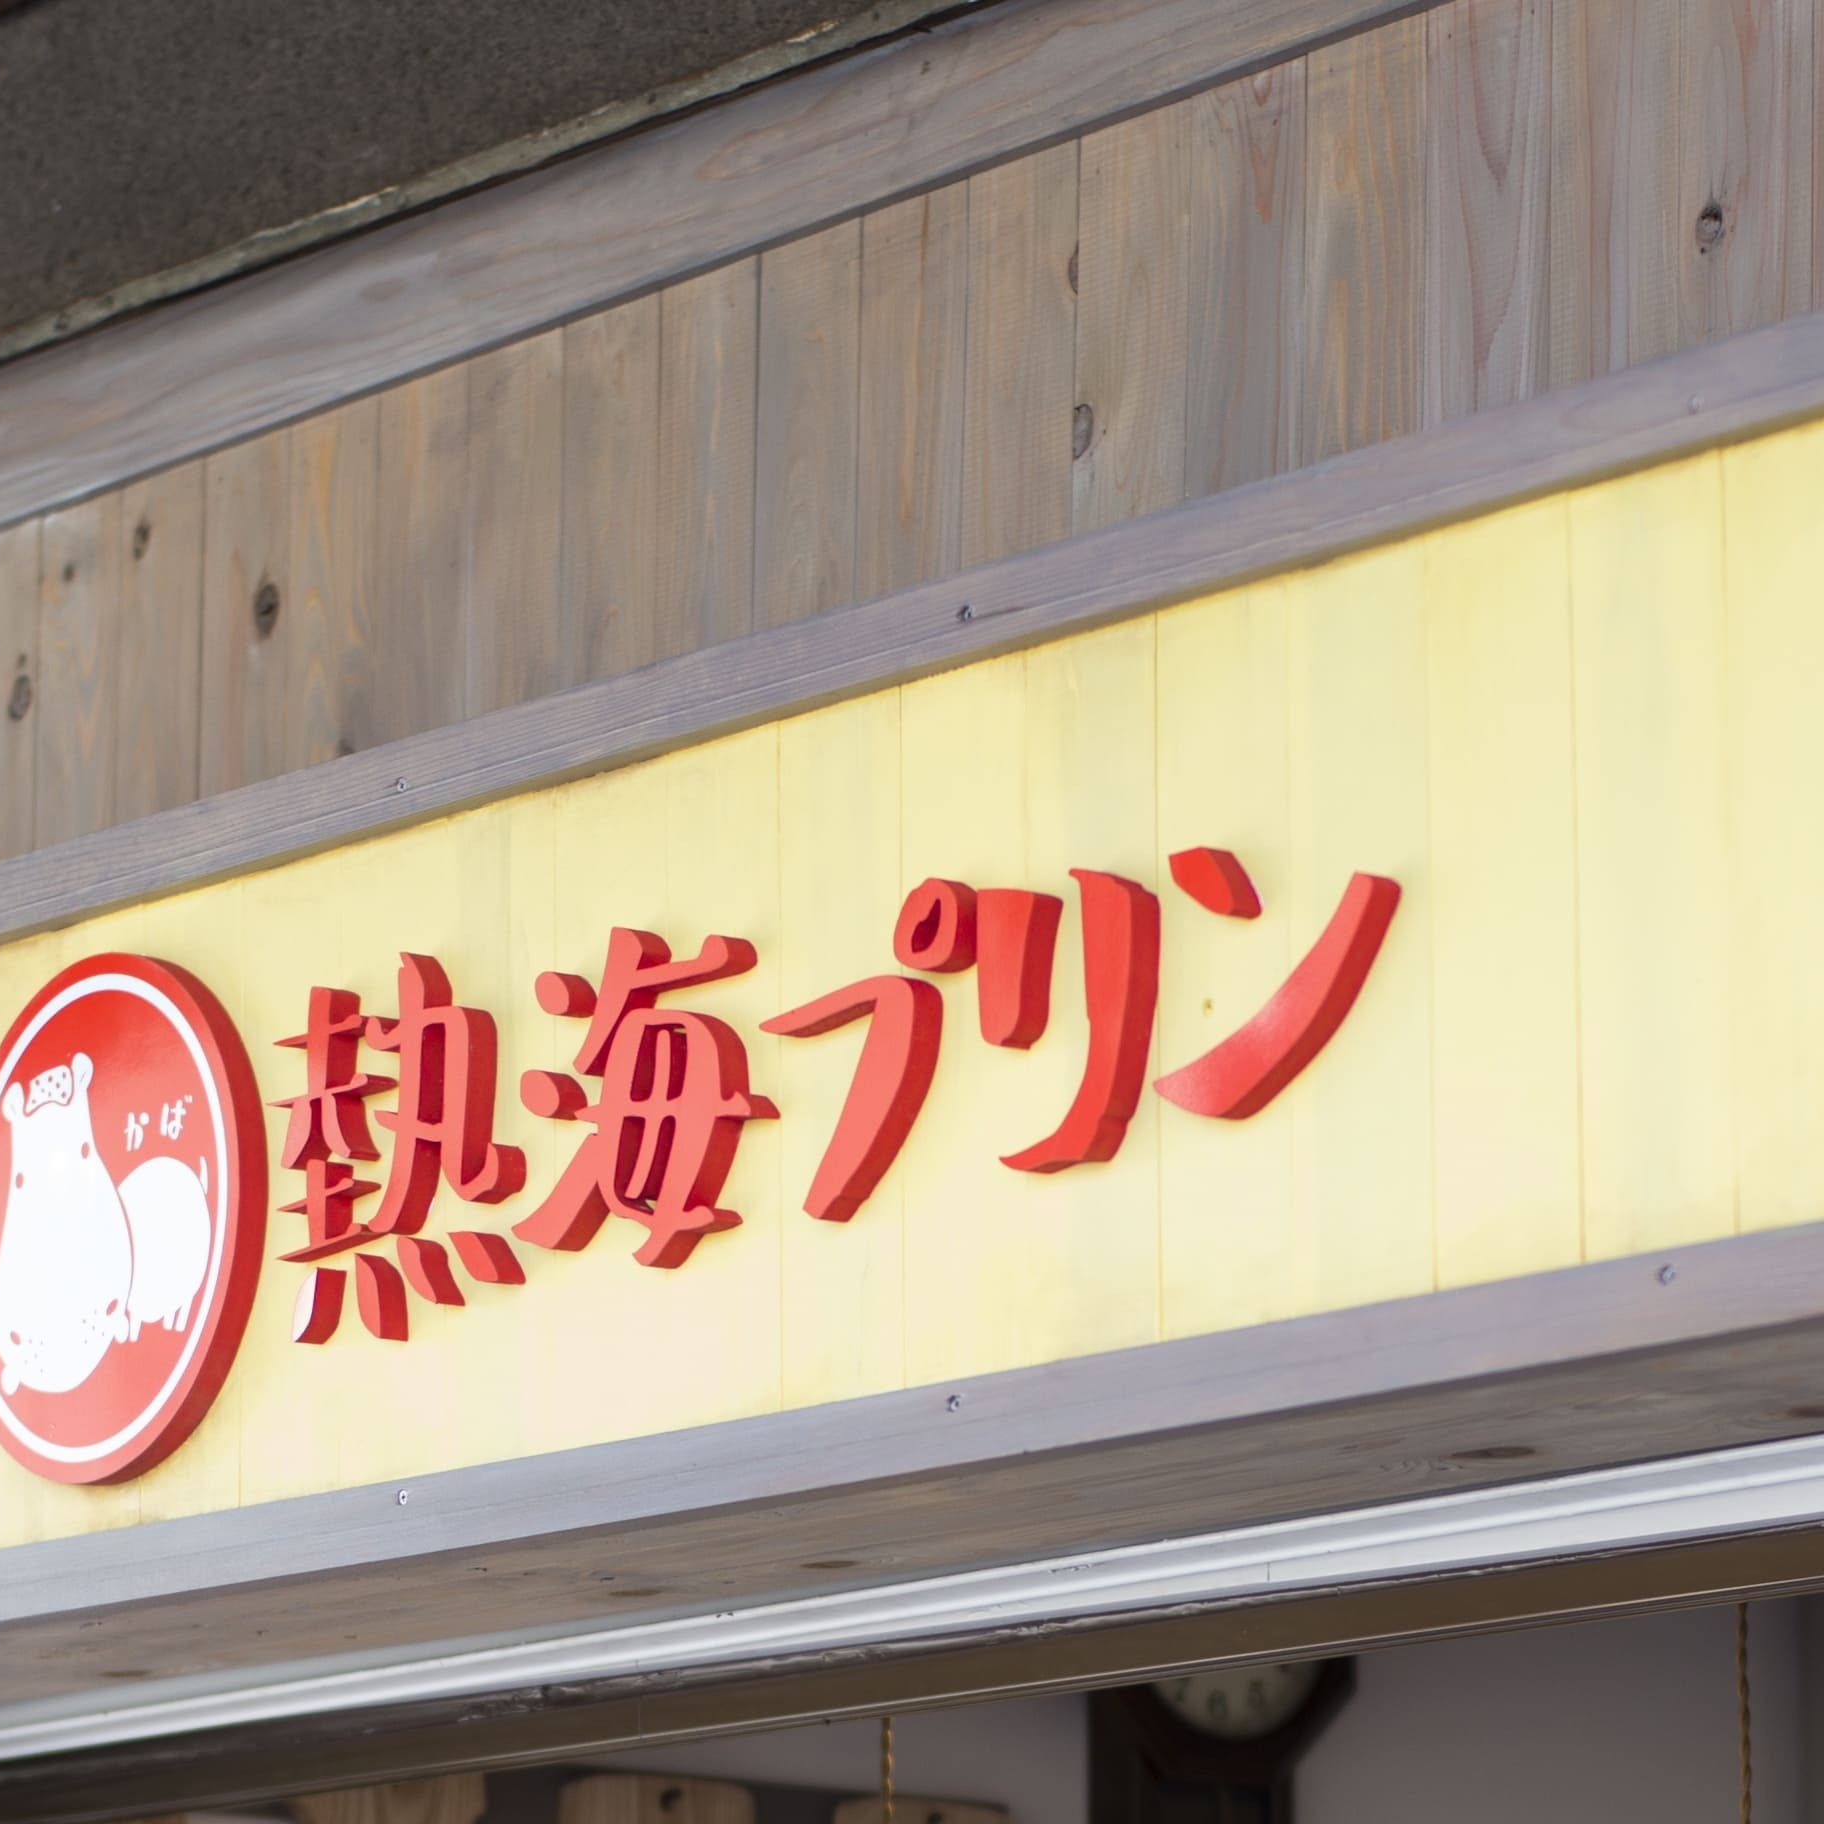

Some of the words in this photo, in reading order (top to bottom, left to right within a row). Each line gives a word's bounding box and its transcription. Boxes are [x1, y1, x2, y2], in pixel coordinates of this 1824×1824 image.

[123, 1095, 193, 1152] かば
[268, 848, 1401, 1344] 熱海プリン
